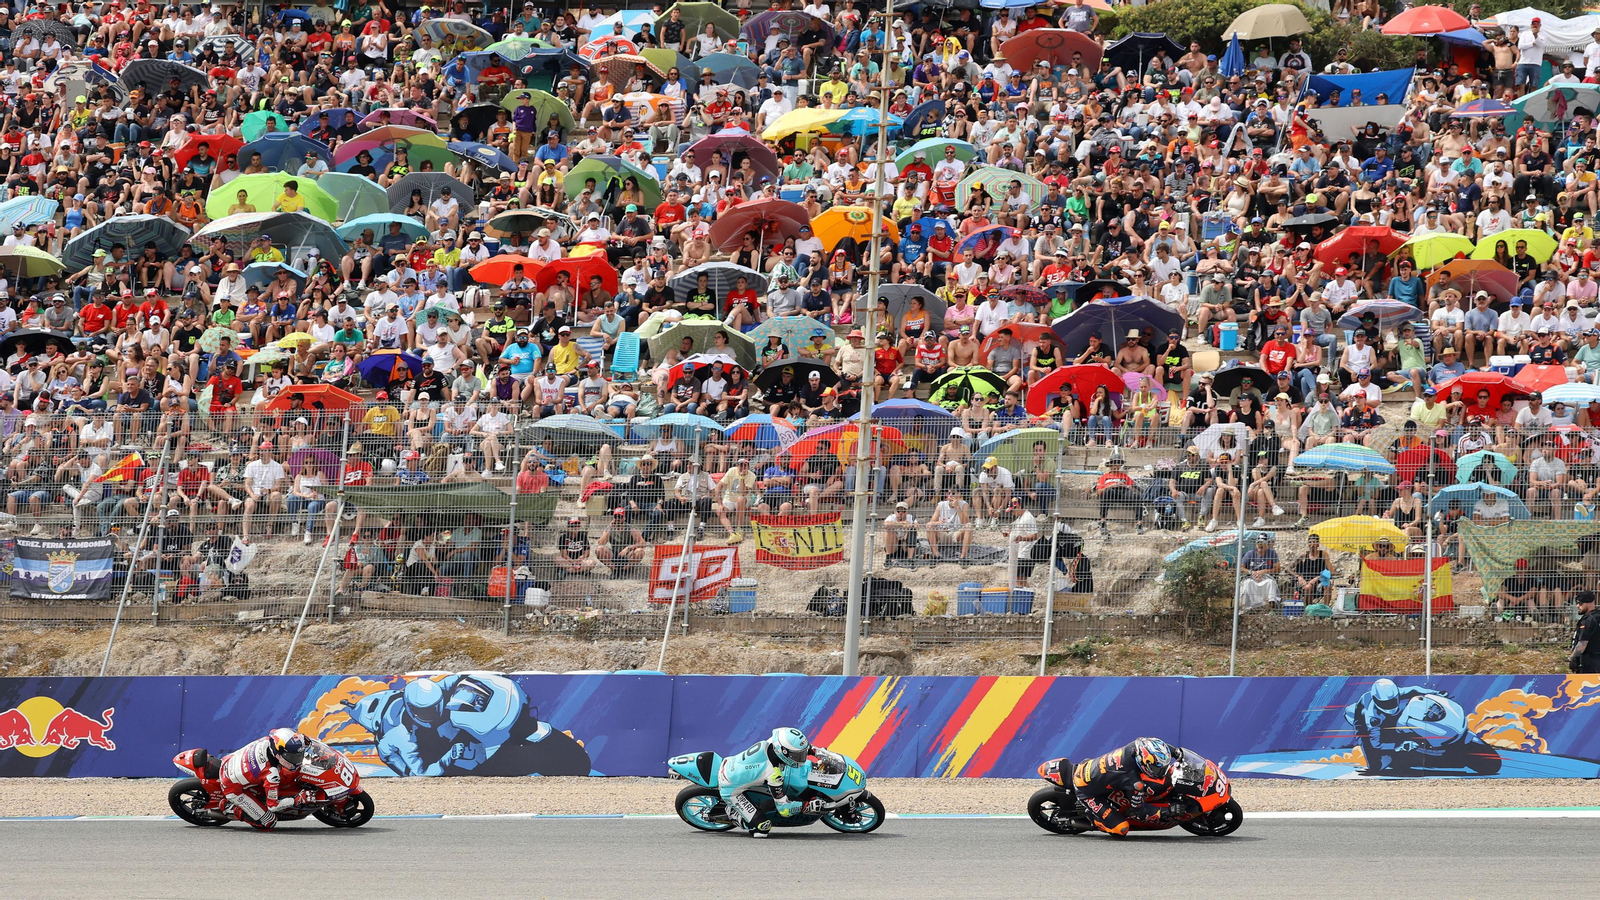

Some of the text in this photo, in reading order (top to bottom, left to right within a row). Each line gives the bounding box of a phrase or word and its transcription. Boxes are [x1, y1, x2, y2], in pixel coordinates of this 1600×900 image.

[1179, 470, 1202, 480] 46
[42, 541, 66, 549] FERIA.
[66, 539, 112, 549] ZAMBOMBA
